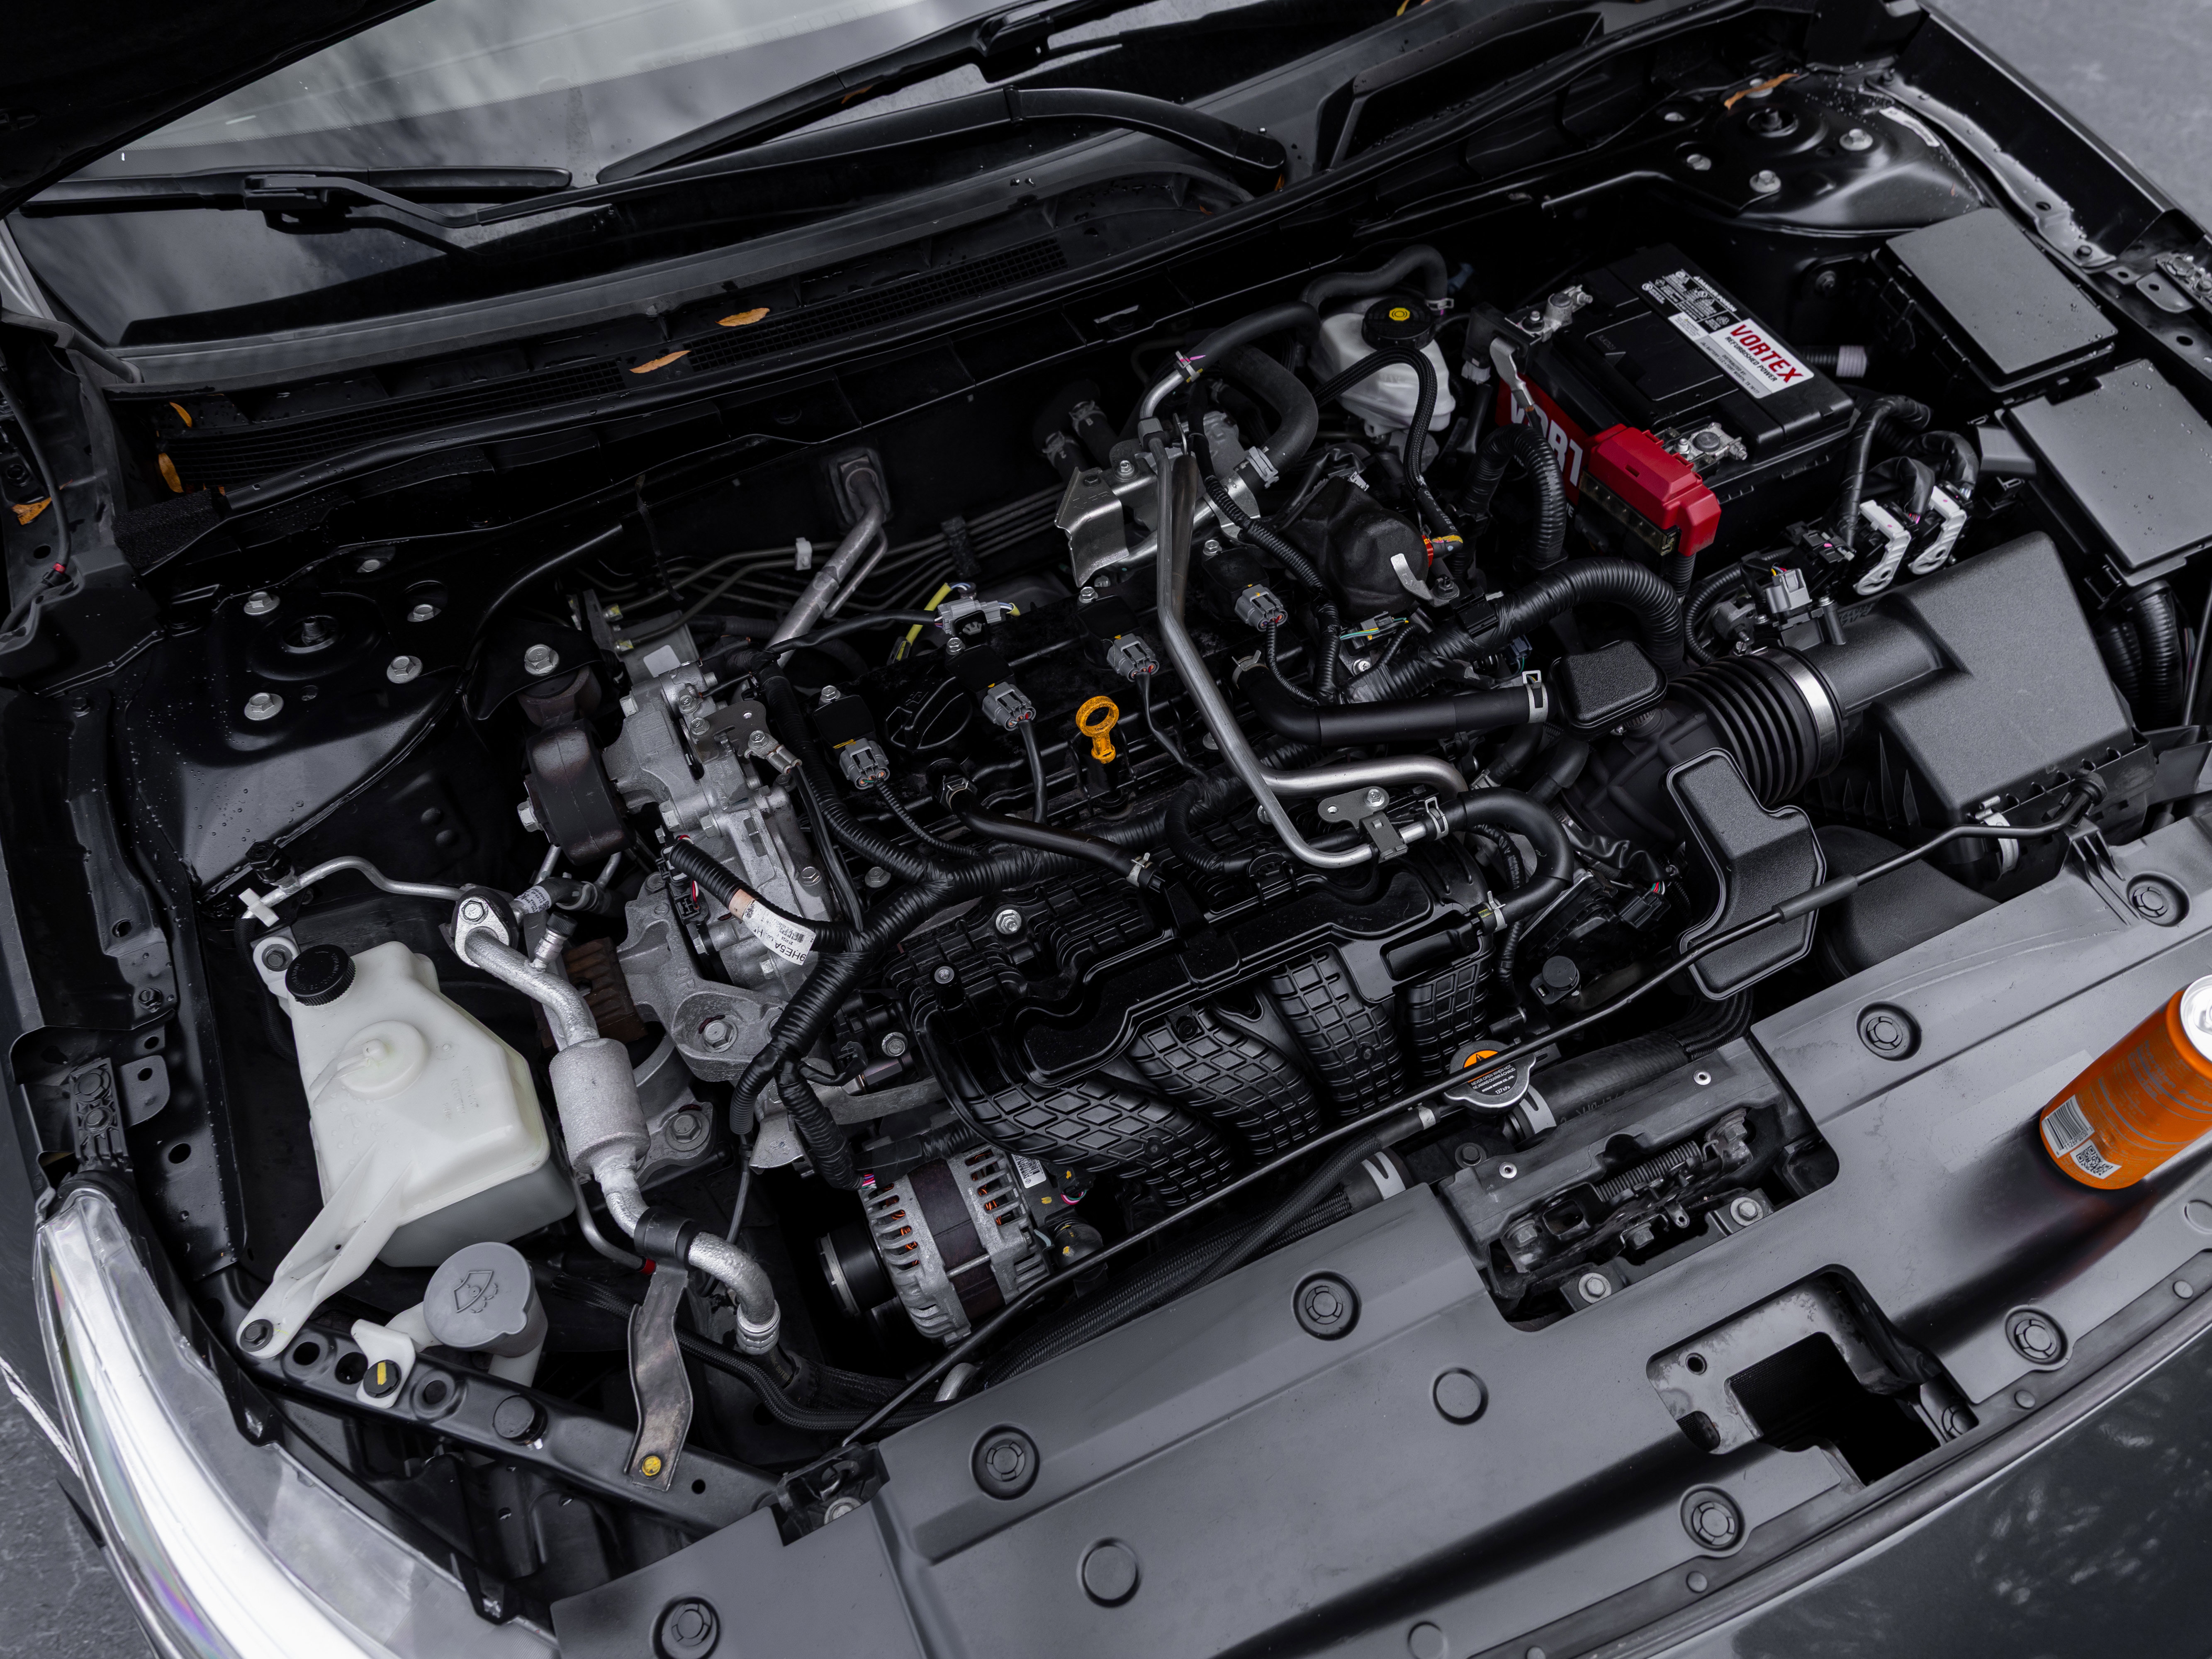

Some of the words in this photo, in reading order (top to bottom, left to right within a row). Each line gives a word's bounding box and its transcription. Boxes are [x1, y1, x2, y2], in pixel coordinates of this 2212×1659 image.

[1706, 346, 1719, 358] BATTERY
[1725, 336, 1758, 365] REFURBISHED
[1756, 365, 1777, 382] POWER
[1730, 324, 1803, 384] VORTEX
[775, 941, 806, 961] 9HE5A
[1017, 1161, 1027, 1179] NISSAN
